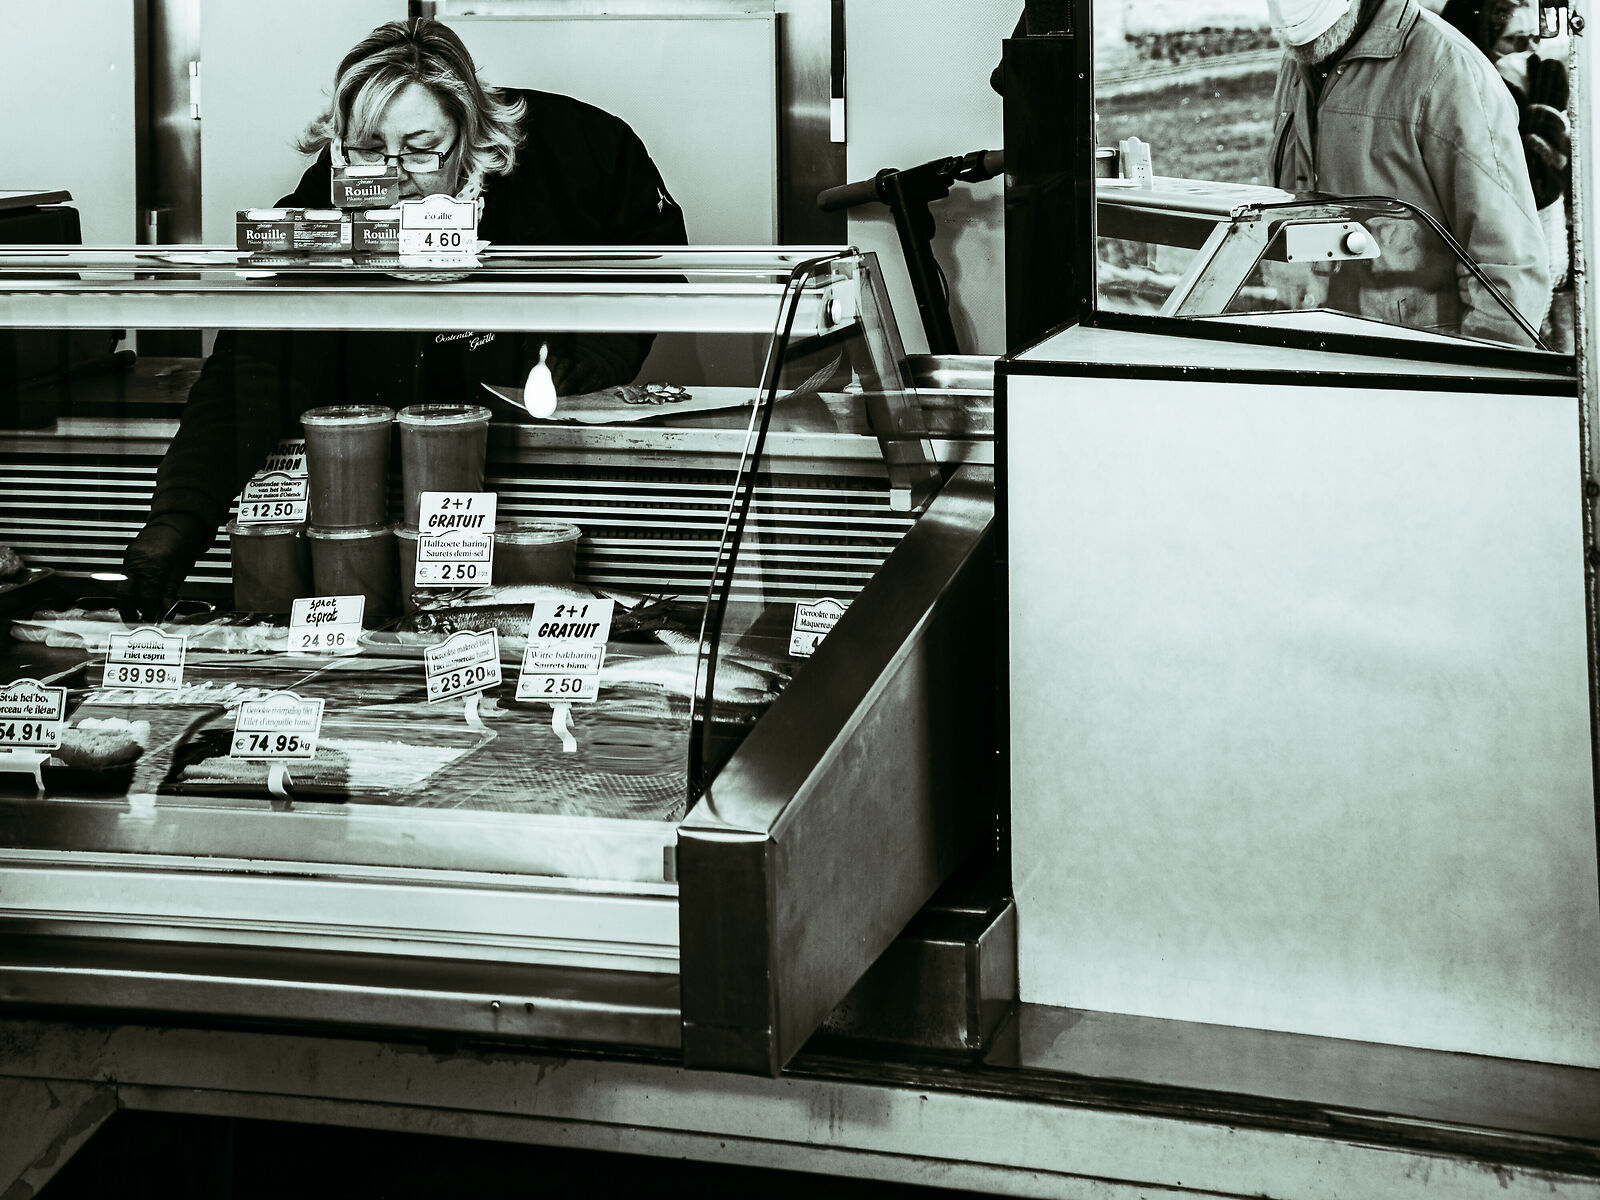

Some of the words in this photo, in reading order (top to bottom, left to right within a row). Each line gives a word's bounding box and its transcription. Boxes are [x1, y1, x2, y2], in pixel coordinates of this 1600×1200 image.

[344, 184, 388, 196] Rouille
[246, 229, 287, 240] Rouille
[440, 497, 473, 510] 2+1
[428, 513, 486, 528] GRATUIT
[462, 539, 488, 549] haring
[309, 598, 337, 611] sprot
[553, 604, 589, 618] 2+1
[305, 607, 338, 627] esprat
[537, 622, 600, 638] GRATUIT
[45, 728, 56, 740] kg
[300, 740, 311, 750] kg
